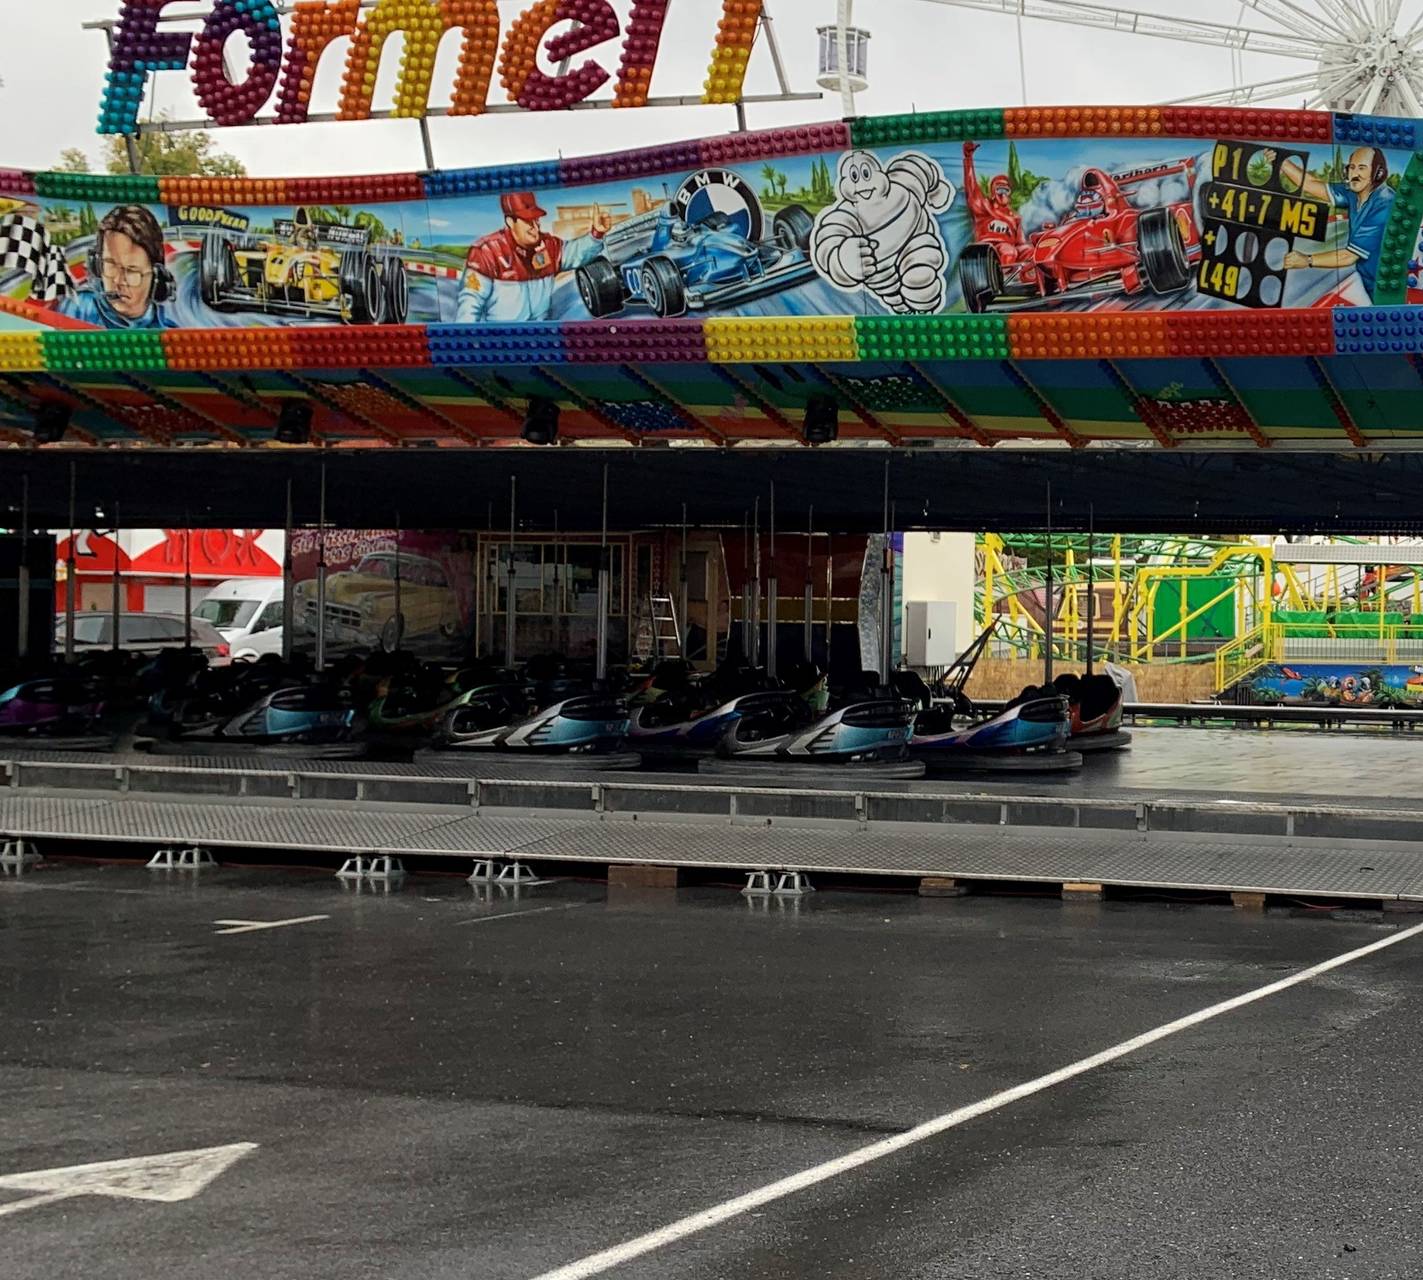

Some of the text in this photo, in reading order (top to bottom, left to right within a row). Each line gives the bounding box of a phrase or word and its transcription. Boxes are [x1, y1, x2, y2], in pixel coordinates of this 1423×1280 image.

[96, 0, 672, 134] Formel
[677, 171, 741, 205] BMW
[178, 205, 248, 231] GOODYEAR
[1279, 199, 1318, 237] MS
[1199, 259, 1240, 297] L49
